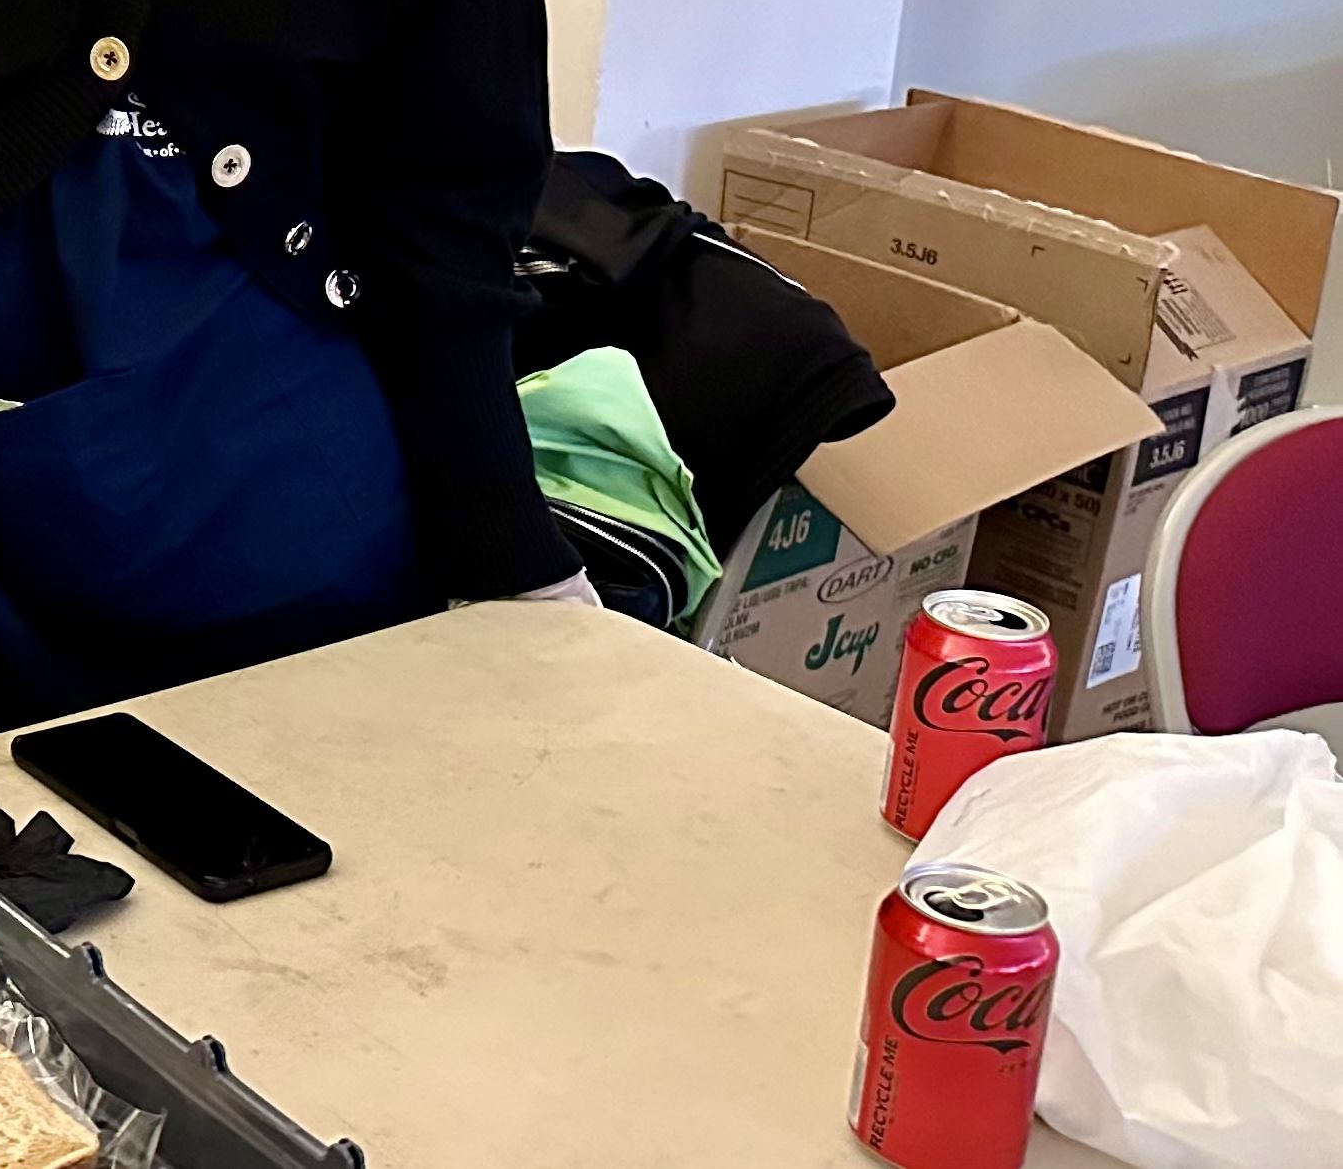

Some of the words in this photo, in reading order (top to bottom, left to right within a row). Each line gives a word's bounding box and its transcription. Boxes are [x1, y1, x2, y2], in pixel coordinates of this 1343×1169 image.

[889, 238, 939, 266] 3.5J6
[768, 509, 812, 552] 4J6
[826, 561, 885, 599] DART
[804, 613, 881, 676] Jcup
[914, 656, 1050, 741] Coca
[894, 750, 916, 829] RECYCLE
[905, 729, 920, 750] ME
[890, 954, 1053, 1054] Coca
[869, 1066, 895, 1151] RECYCLE
[885, 1035, 901, 1065] ME
